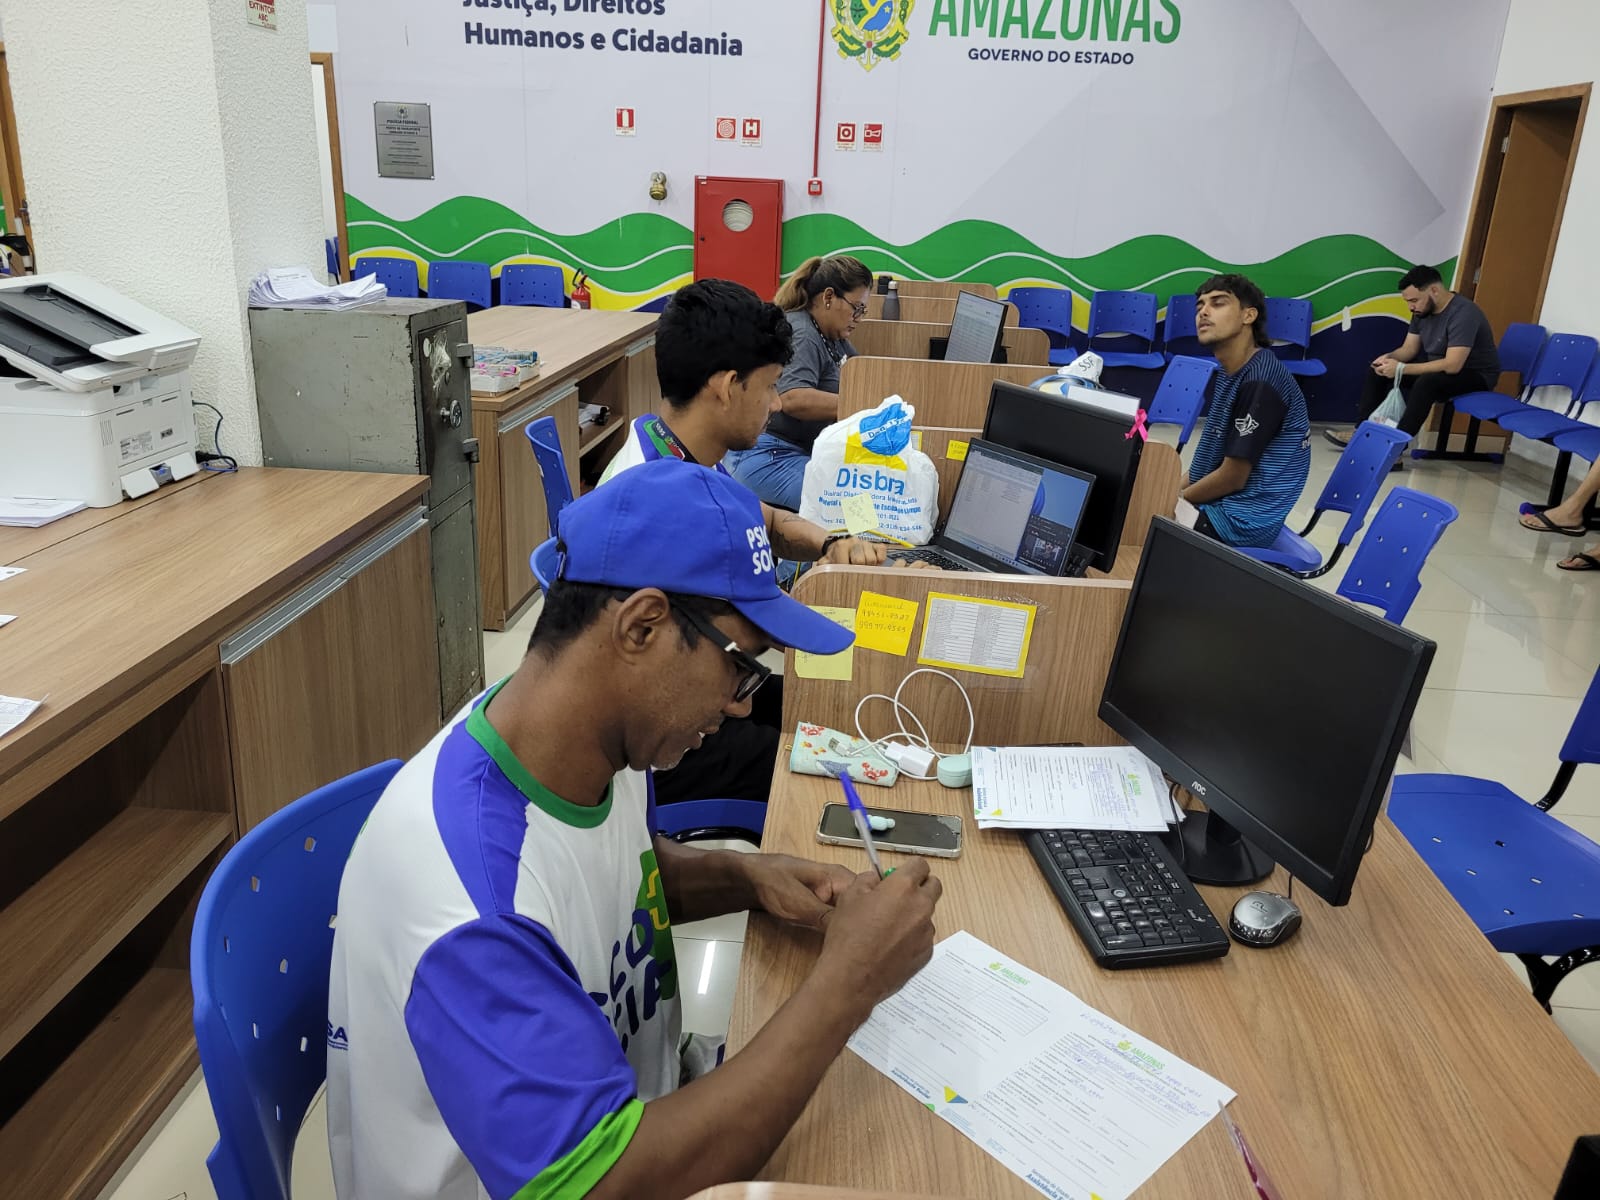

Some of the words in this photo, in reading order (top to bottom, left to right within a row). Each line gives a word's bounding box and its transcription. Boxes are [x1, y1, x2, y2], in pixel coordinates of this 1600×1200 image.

[928, 0, 1181, 44] AMAZONAS
[464, 22, 585, 50] Humanos
[590, 33, 606, 51] e
[612, 28, 743, 56] Cidadania
[967, 47, 1043, 63] GOVERNO
[1047, 50, 1071, 63] DO
[1074, 51, 1135, 66] ESTADO
[1191, 780, 1207, 796] AOC
